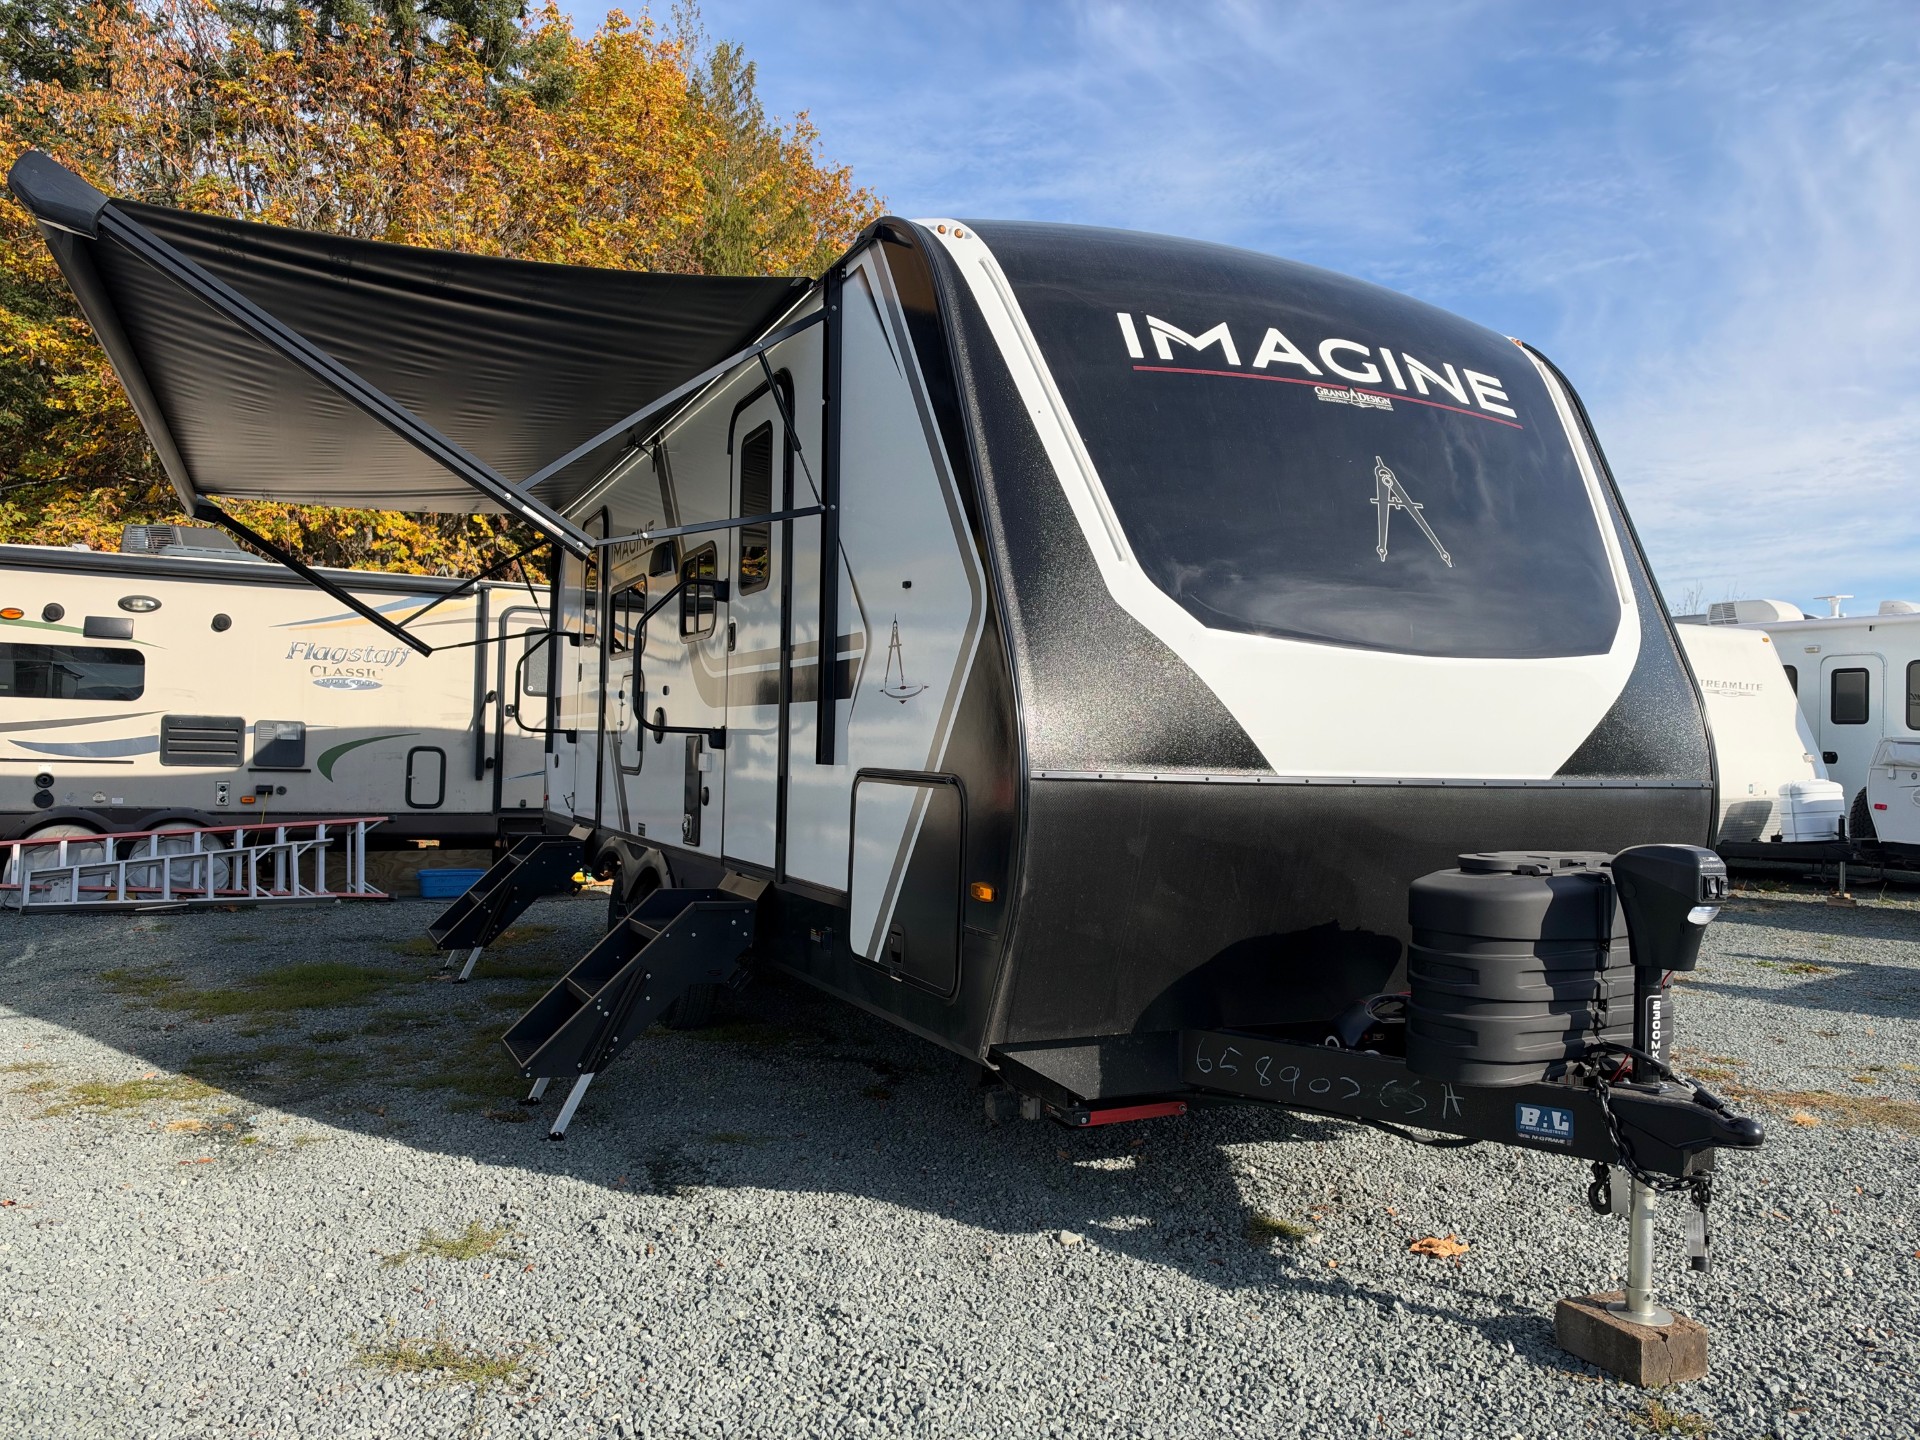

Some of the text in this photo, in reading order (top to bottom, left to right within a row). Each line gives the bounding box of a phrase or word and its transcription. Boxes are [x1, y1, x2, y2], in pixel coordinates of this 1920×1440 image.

[1117, 312, 1518, 419] IMAGINE
[1314, 386, 1392, 406] GRAND DESIGN
[285, 641, 413, 668] Flagstaff
[310, 664, 384, 680] CLASSIC
[1699, 679, 1763, 692] TREAMLITE
[1520, 1106, 1569, 1131] BAL
